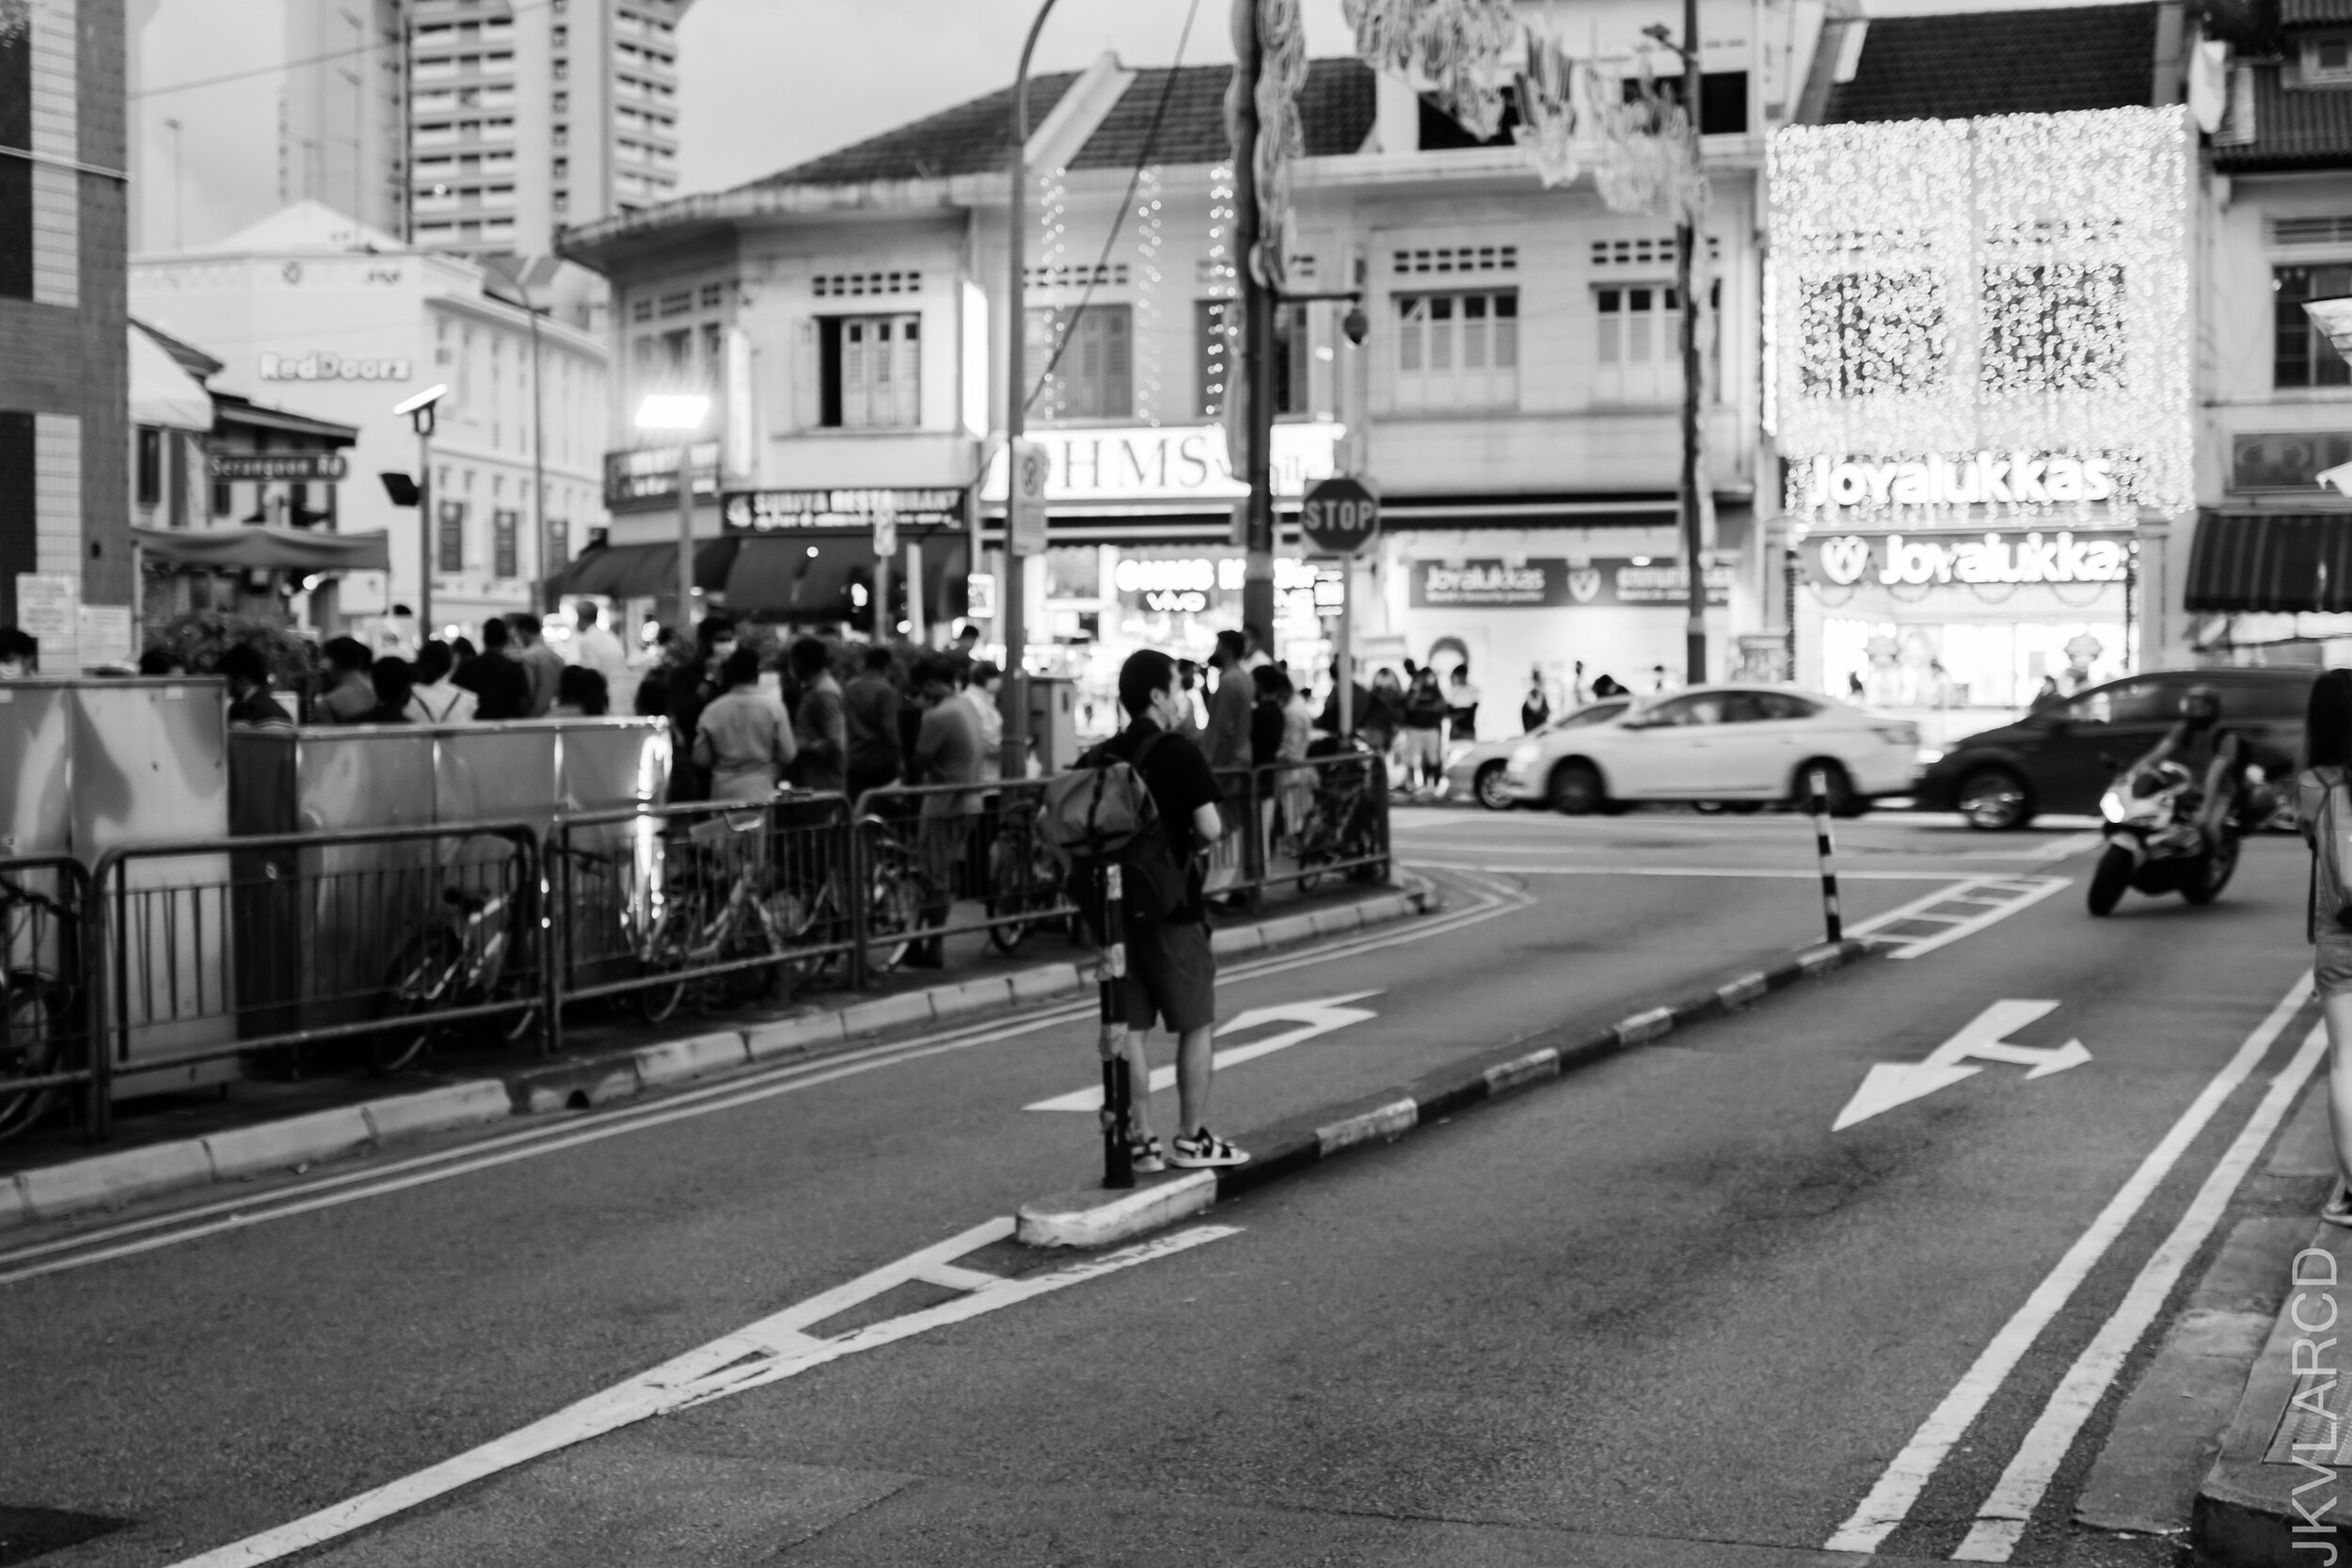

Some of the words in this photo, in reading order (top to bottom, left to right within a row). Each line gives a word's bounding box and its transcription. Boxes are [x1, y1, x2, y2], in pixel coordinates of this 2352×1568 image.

[261, 352, 412, 380] RedDoorz
[210, 455, 309, 481] Serangoon
[317, 454, 342, 476] Rd
[1807, 451, 2112, 505] Joyalukkas
[1304, 500, 1375, 531] STOP
